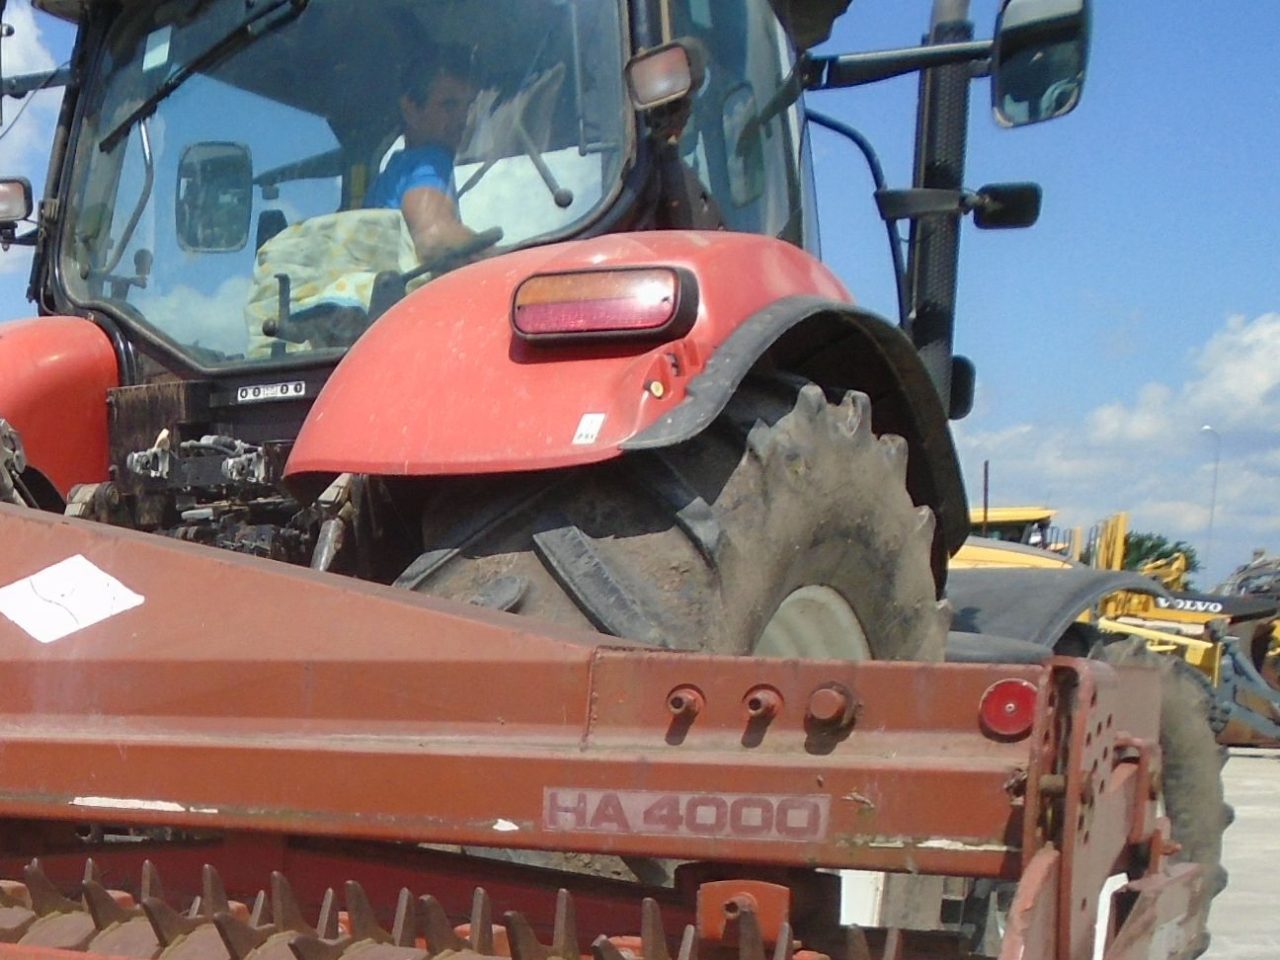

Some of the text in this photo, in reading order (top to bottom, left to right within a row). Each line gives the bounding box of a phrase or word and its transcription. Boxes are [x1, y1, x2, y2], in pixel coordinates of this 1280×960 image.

[1156, 597, 1223, 613] VOLVO
[547, 791, 821, 837] HA 4000
